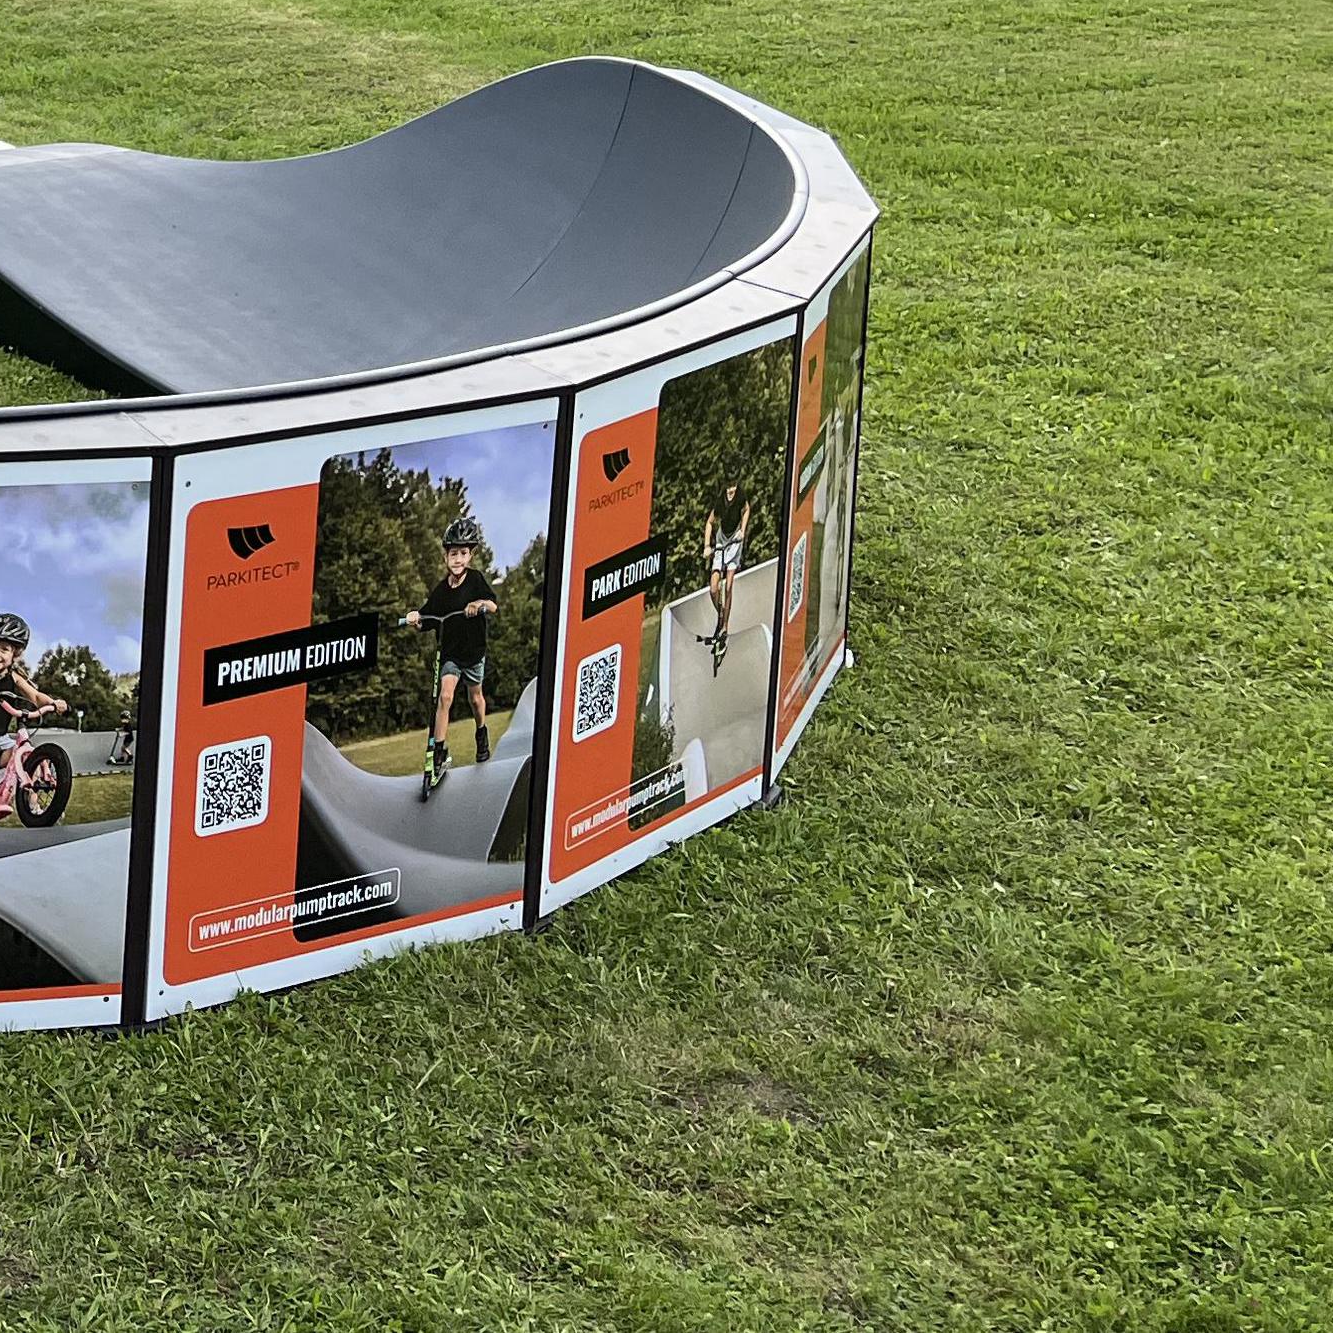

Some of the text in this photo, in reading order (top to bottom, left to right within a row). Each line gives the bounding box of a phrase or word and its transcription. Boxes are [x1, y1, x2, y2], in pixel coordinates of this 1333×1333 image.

[591, 552, 661, 602] PARK EDITION
[217, 634, 367, 687] PREMIUM EDITION
[198, 878, 393, 941] www.modularpumptrack.com
